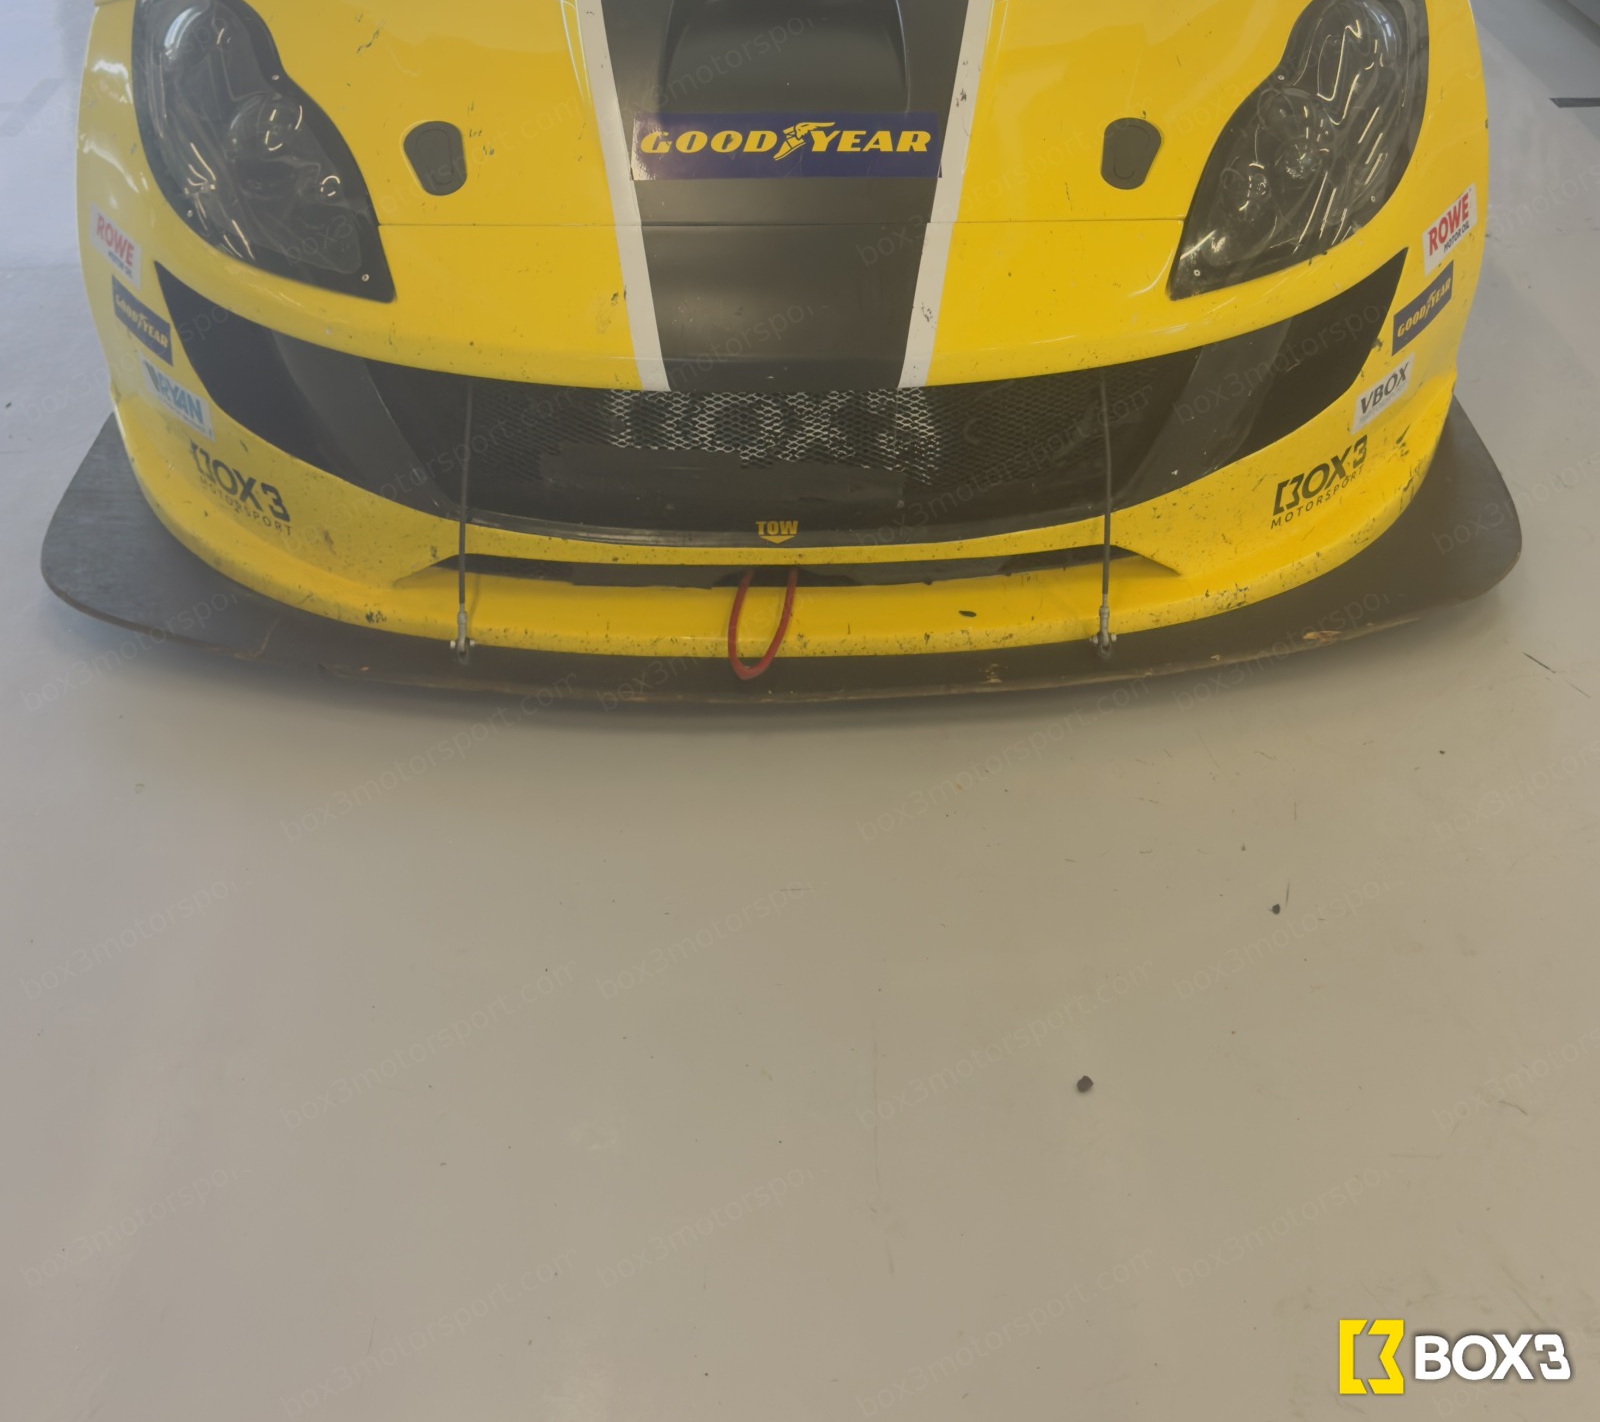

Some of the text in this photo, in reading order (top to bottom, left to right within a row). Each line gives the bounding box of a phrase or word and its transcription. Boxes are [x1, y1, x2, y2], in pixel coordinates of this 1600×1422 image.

[639, 128, 932, 156] GOODYEAR
[96, 213, 134, 268] ROWE
[1427, 193, 1469, 257] ROWE
[115, 292, 168, 349] GOODYEAR
[1397, 277, 1451, 338] GOODYEAR
[1361, 361, 1409, 415] VBOX
[1270, 464, 1364, 530] MOTORSPORT
[1273, 434, 1368, 516] BOX3
[199, 476, 292, 536] MOTORSPORT
[755, 520, 799, 536] TOW
